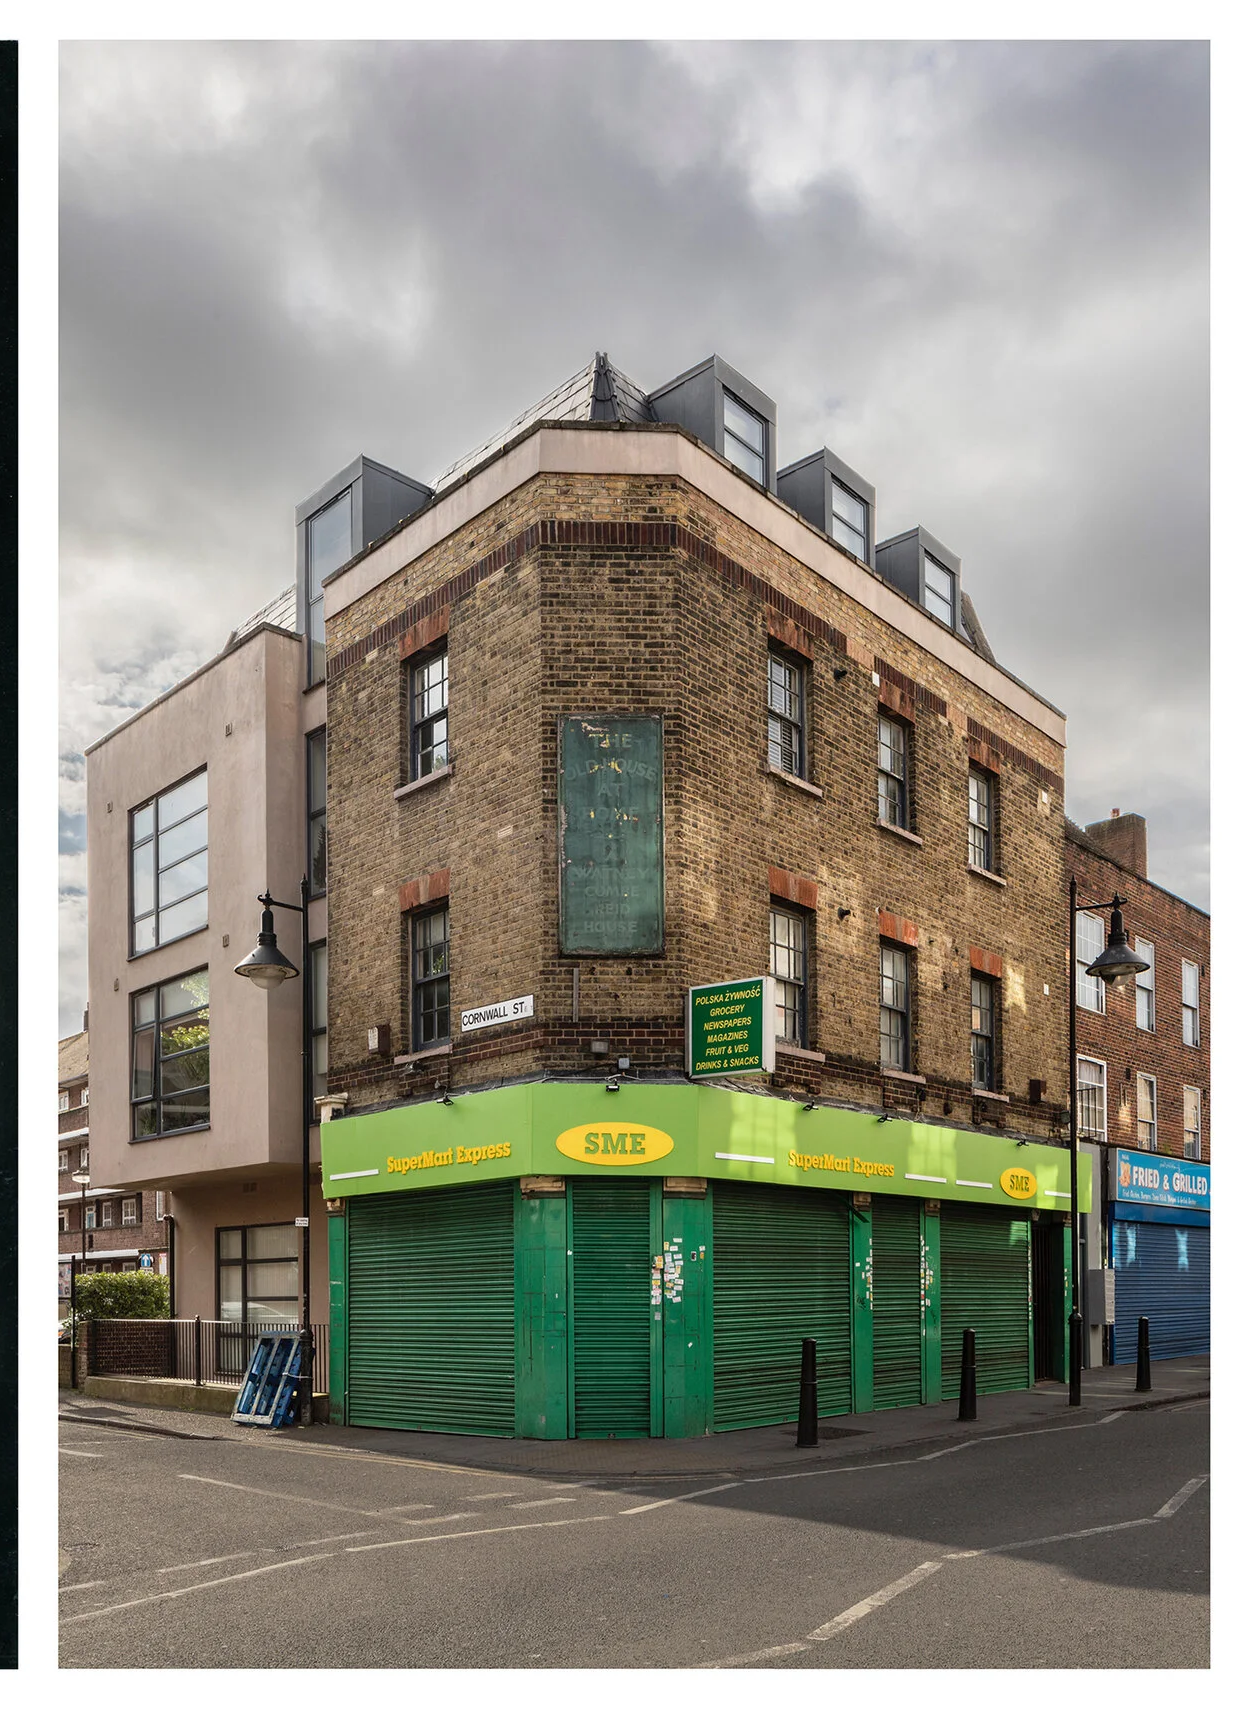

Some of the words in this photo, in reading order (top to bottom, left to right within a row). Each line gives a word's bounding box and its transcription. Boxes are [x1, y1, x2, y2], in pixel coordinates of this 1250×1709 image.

[588, 733, 632, 748] THE
[565, 760, 599, 781] OLD
[696, 994, 723, 1005] POLSKA
[462, 1006, 508, 1026] CORNWALL
[710, 1004, 745, 1016] GROCERY
[704, 1017, 751, 1030] NEWSPAPERS
[707, 1031, 748, 1043] MAGAZINES
[706, 1047, 726, 1056] FRUIT
[727, 1045, 733, 1054] &
[735, 1044, 749, 1053] VEG
[696, 1061, 721, 1070] DRINKS
[723, 1059, 729, 1068] &
[730, 1056, 759, 1066] SNACKS
[584, 1132, 646, 1155] SME
[387, 1149, 454, 1175] SuperMart
[456, 1142, 511, 1166] Express
[788, 1150, 851, 1173] SuperMart
[853, 1157, 895, 1177] Express
[1009, 1174, 1030, 1192] SME
[1133, 1166, 1159, 1189] FRIED
[1163, 1174, 1169, 1190] &
[1173, 1172, 1207, 1195] GRILLED
